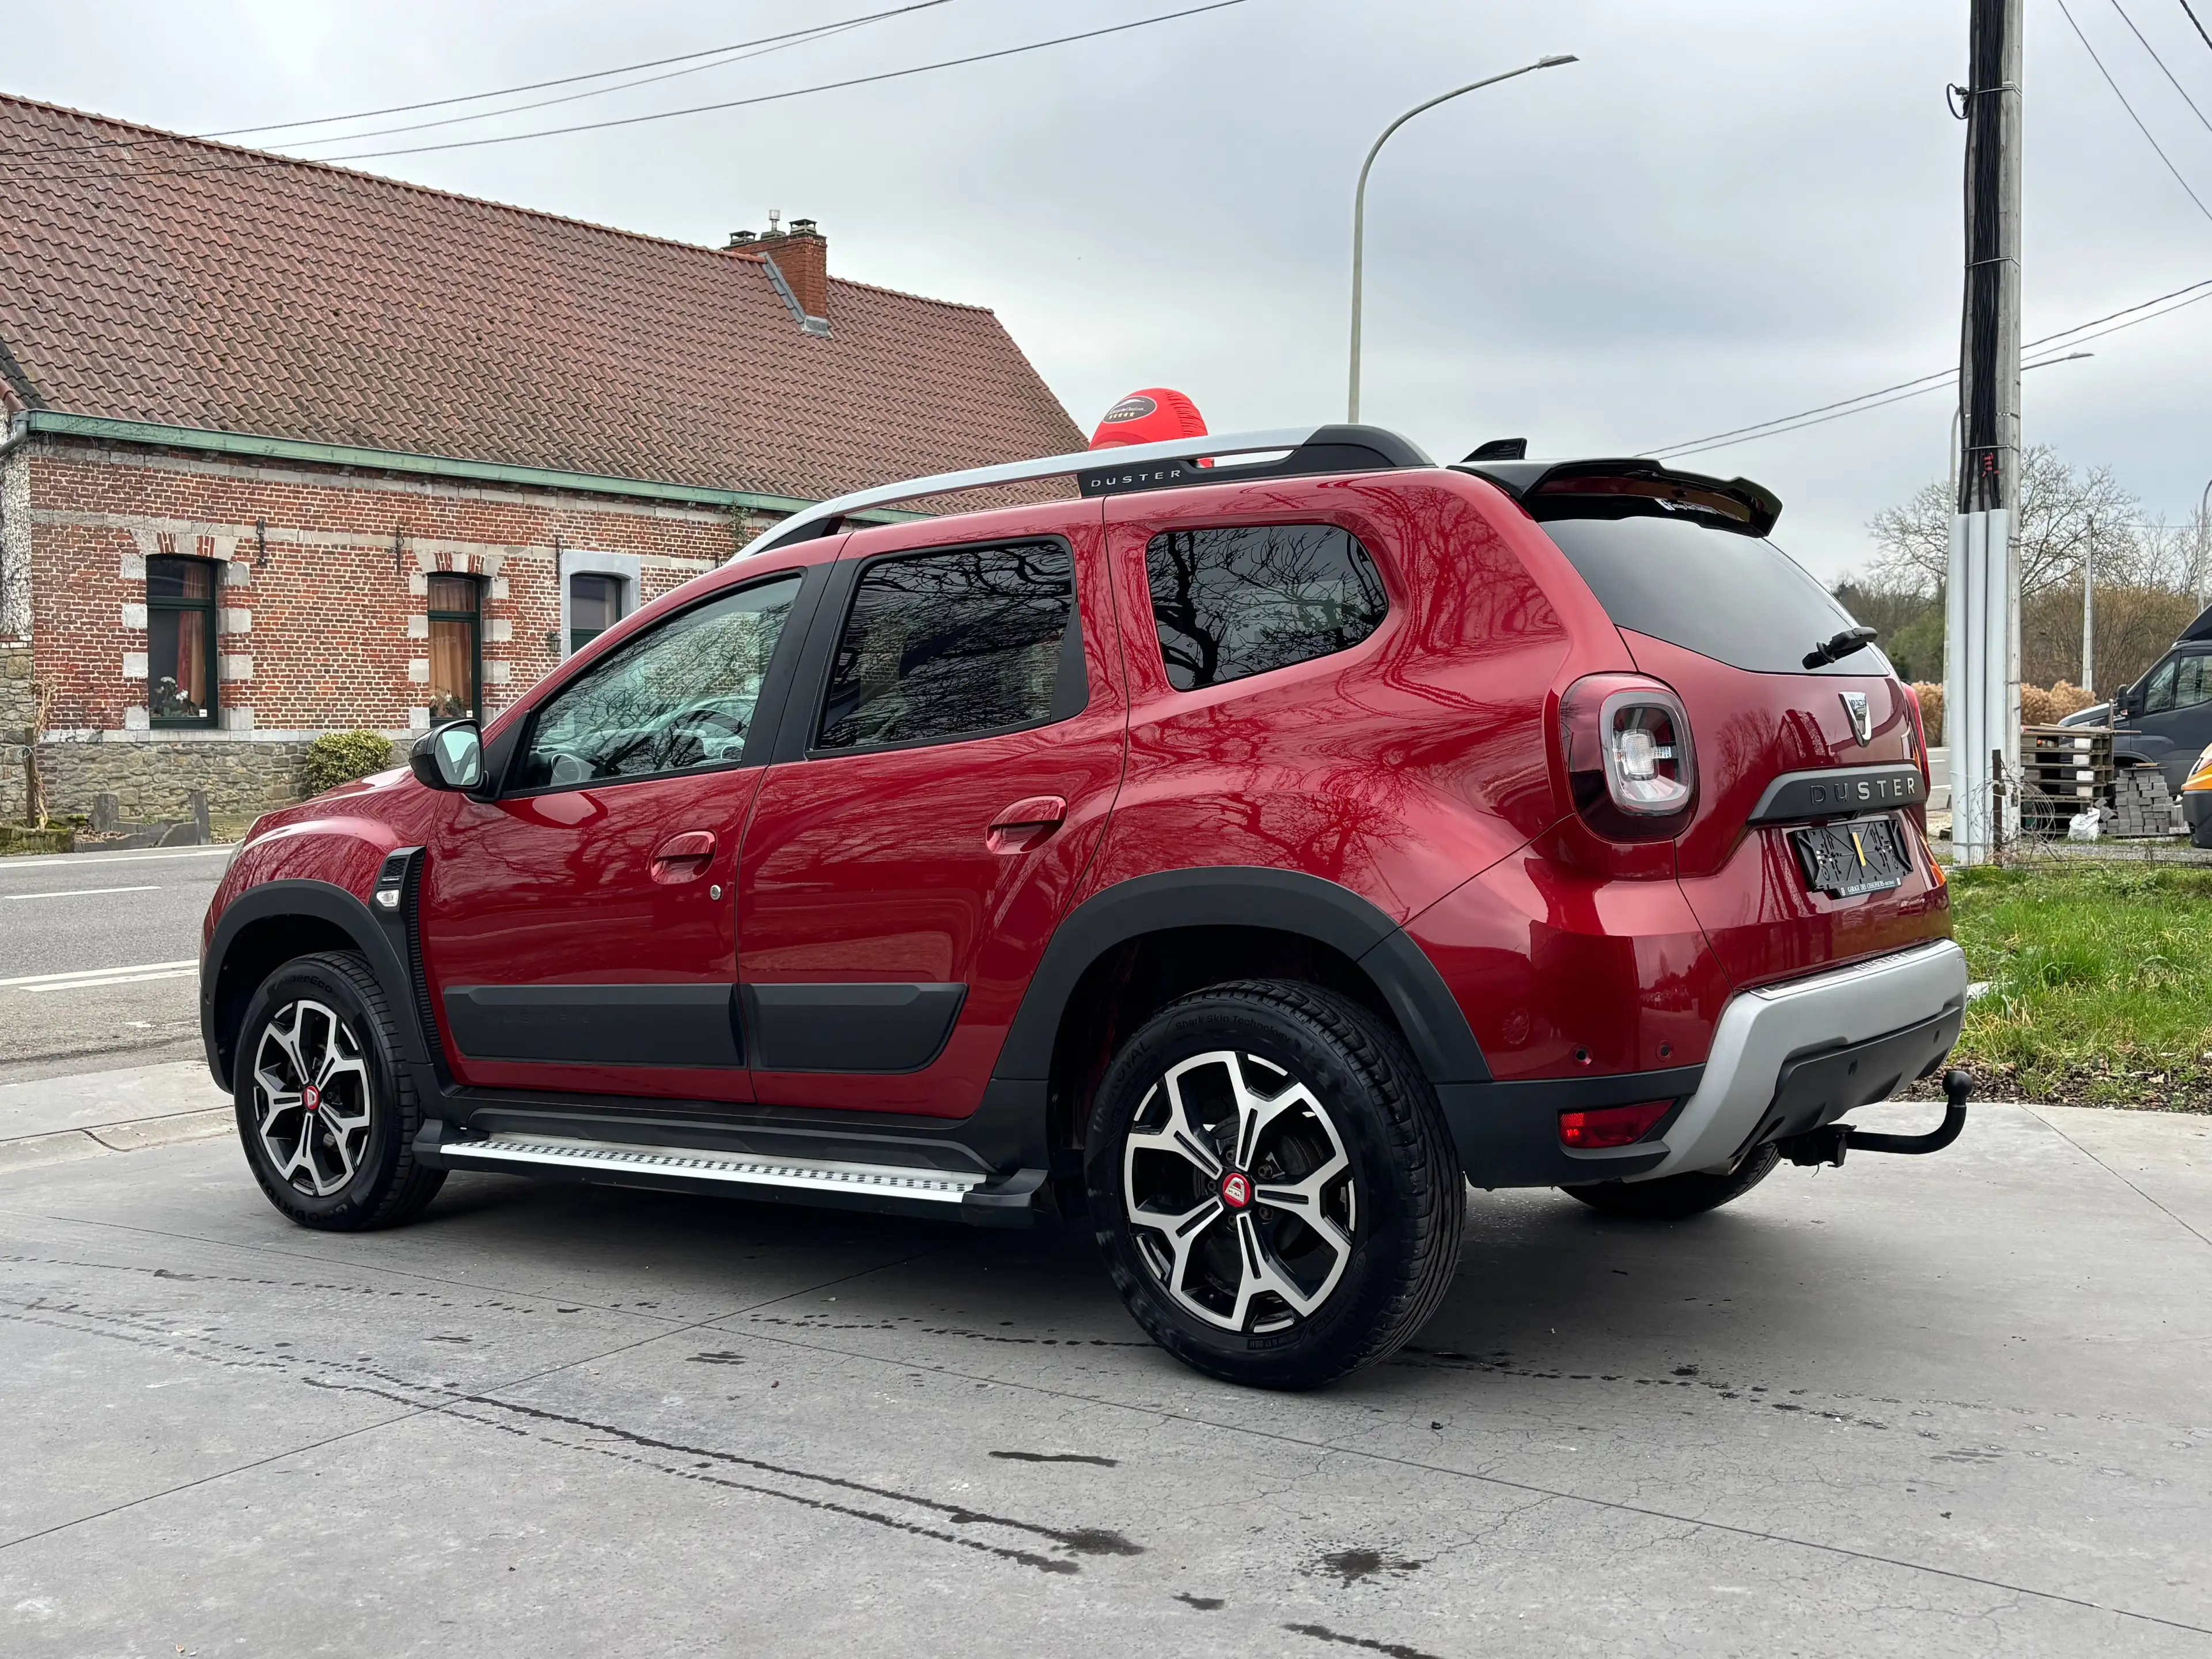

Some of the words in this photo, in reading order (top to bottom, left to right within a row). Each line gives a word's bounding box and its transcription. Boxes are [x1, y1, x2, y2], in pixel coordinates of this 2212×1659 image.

[1090, 469, 1181, 487] DUSTER
[1809, 777, 1915, 805] DUSTER
[1175, 1016, 1205, 1030] Shark
[1206, 1013, 1229, 1024] Skin
